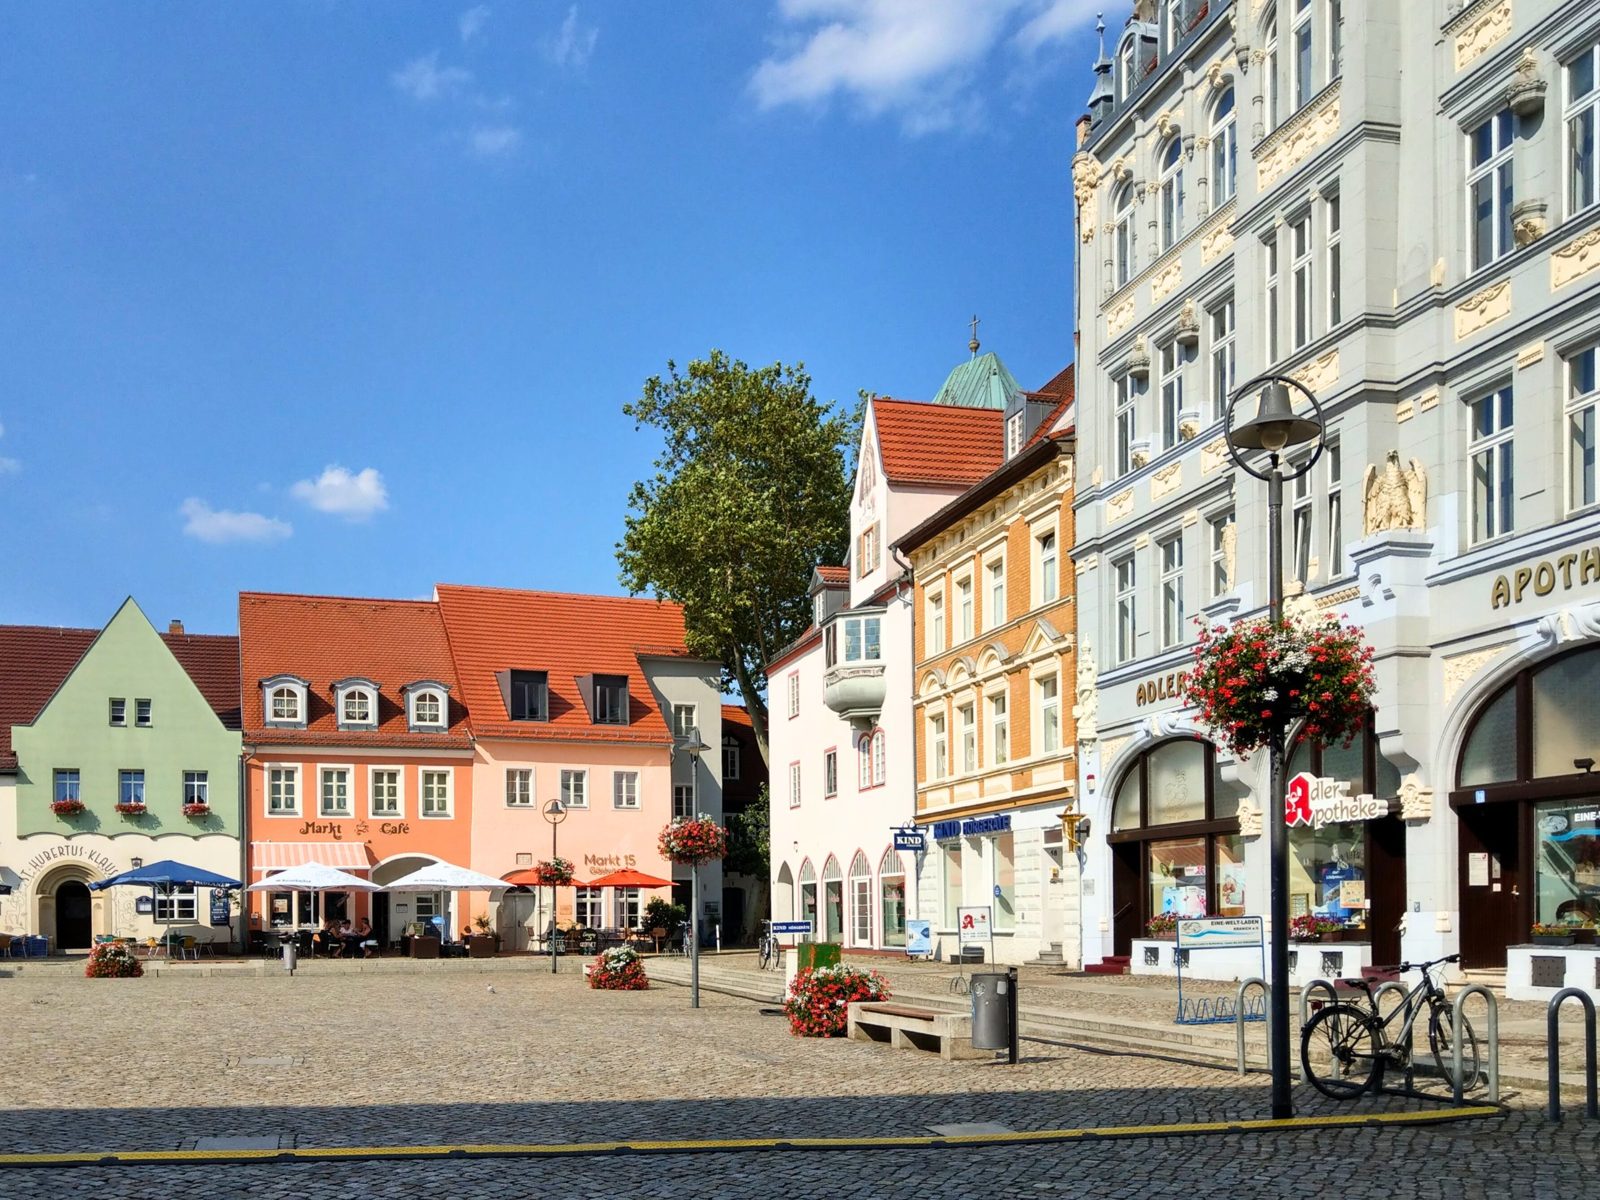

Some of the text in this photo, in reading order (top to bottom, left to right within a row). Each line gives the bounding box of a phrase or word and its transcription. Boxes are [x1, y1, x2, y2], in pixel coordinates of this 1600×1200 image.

[1491, 546, 1600, 610] APOTH
[1136, 671, 1188, 707] ADLER
[300, 821, 410, 840] Markt Café
[896, 836, 922, 845] KIND
[28, 845, 84, 870] HUBERTUS
[88, 849, 119, 877] KLAUS
[584, 853, 637, 866] Markt 15
